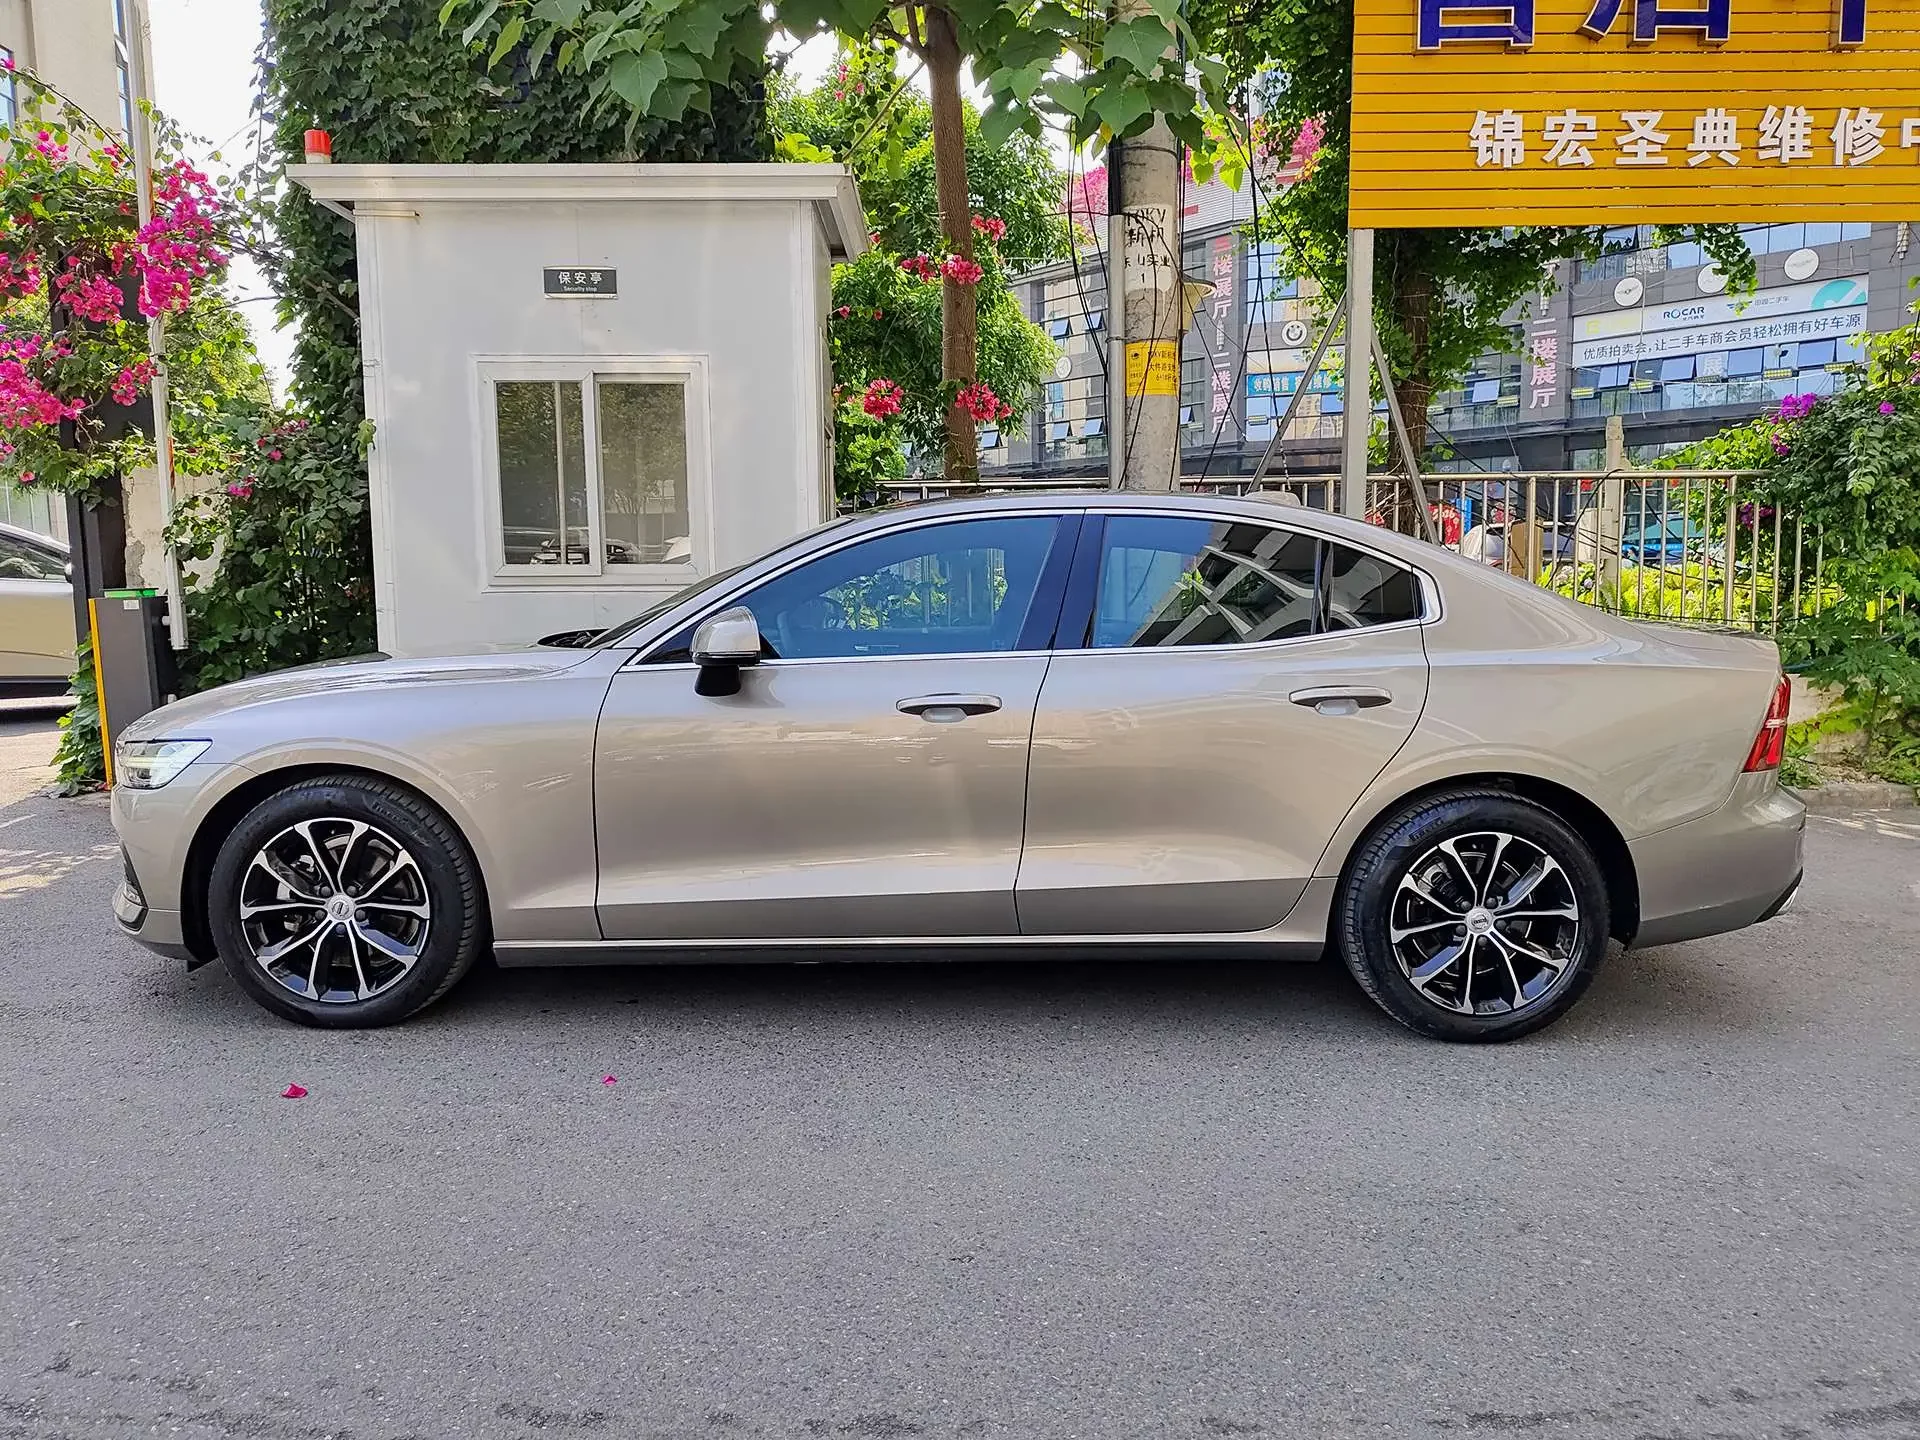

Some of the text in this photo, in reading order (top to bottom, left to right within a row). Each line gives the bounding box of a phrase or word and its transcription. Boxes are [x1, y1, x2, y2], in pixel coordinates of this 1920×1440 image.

[558, 271, 602, 284] 保安亭
[1663, 306, 1705, 319] ROCAR
[1529, 317, 1558, 409] 二楼展厅
[1211, 352, 1231, 434] 二楼展厅
